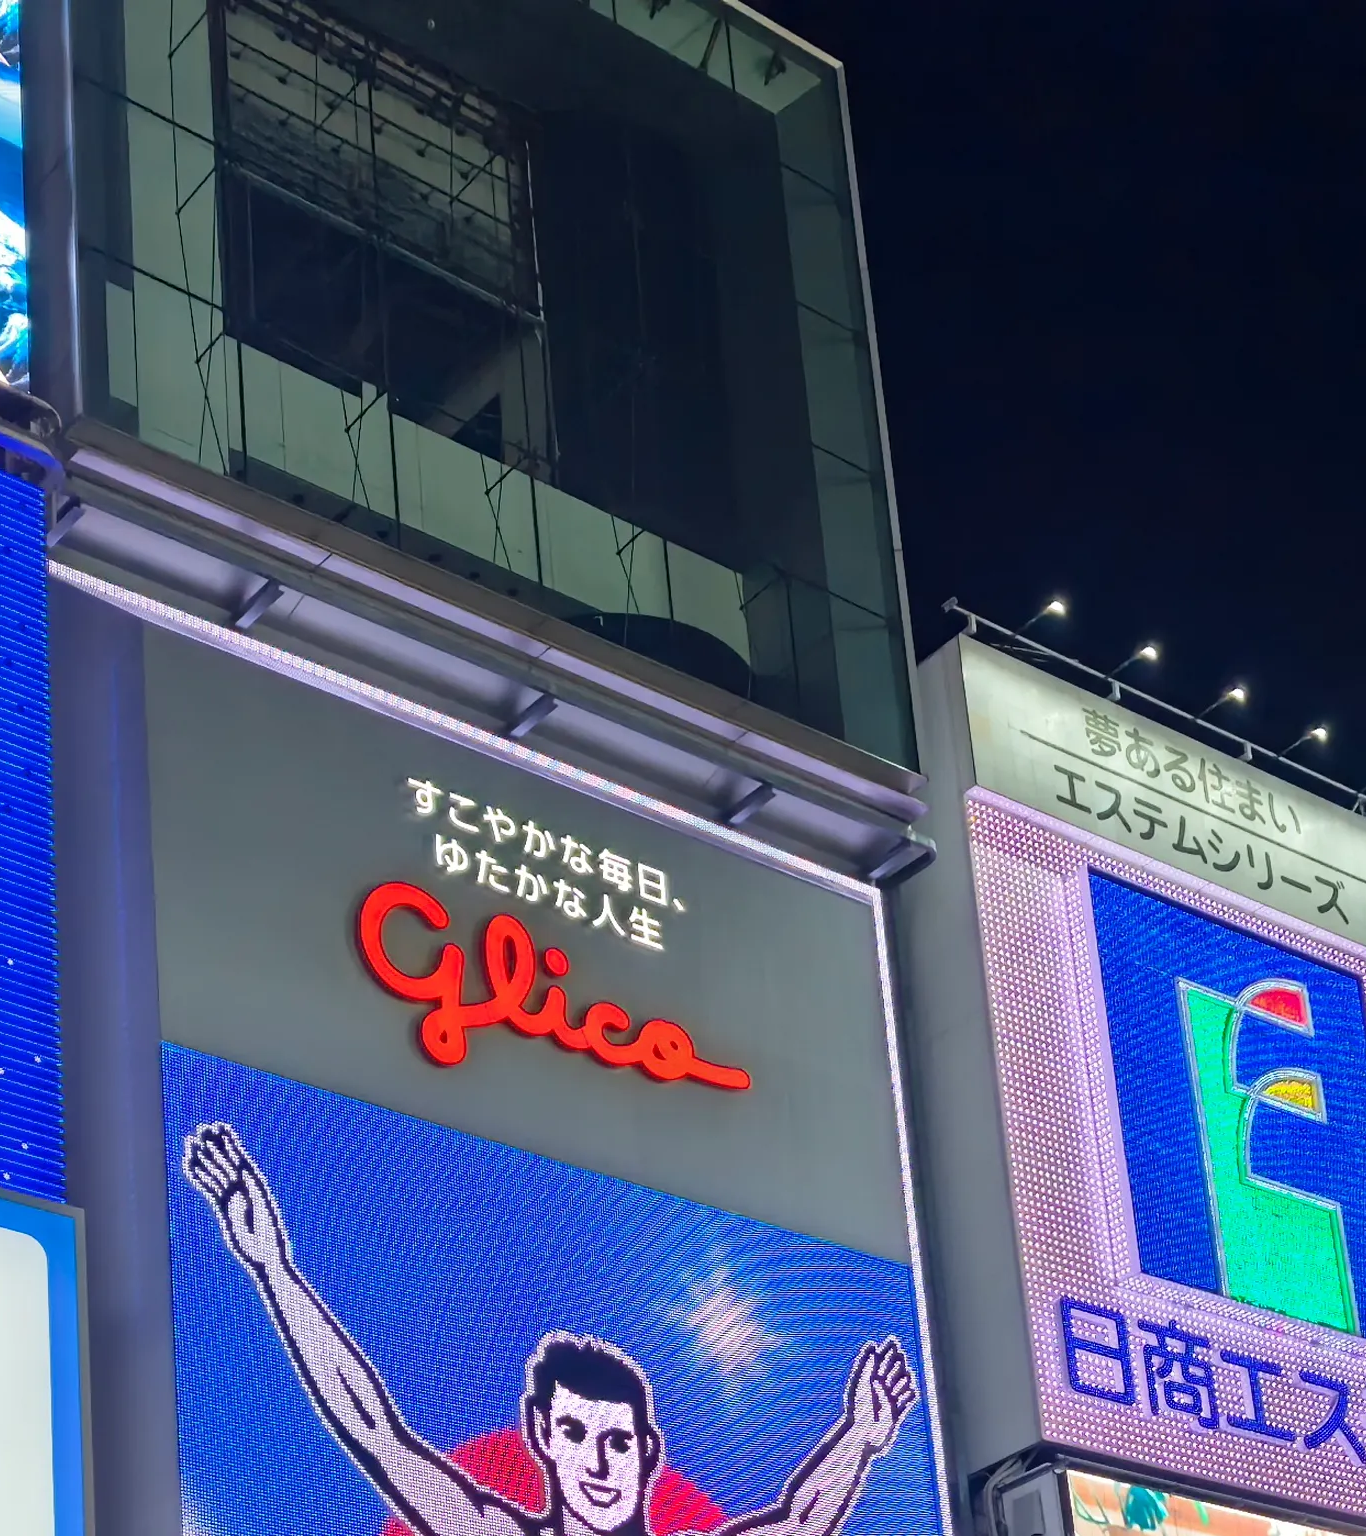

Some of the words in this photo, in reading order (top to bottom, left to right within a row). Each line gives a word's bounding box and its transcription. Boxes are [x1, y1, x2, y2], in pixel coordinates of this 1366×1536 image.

[1081, 707, 1303, 835] 夢ある住まい
[405, 776, 687, 913] すこやかな毎日、
[434, 834, 665, 951] ゆたかな人生
[1053, 763, 1350, 926] エステムシリーズ
